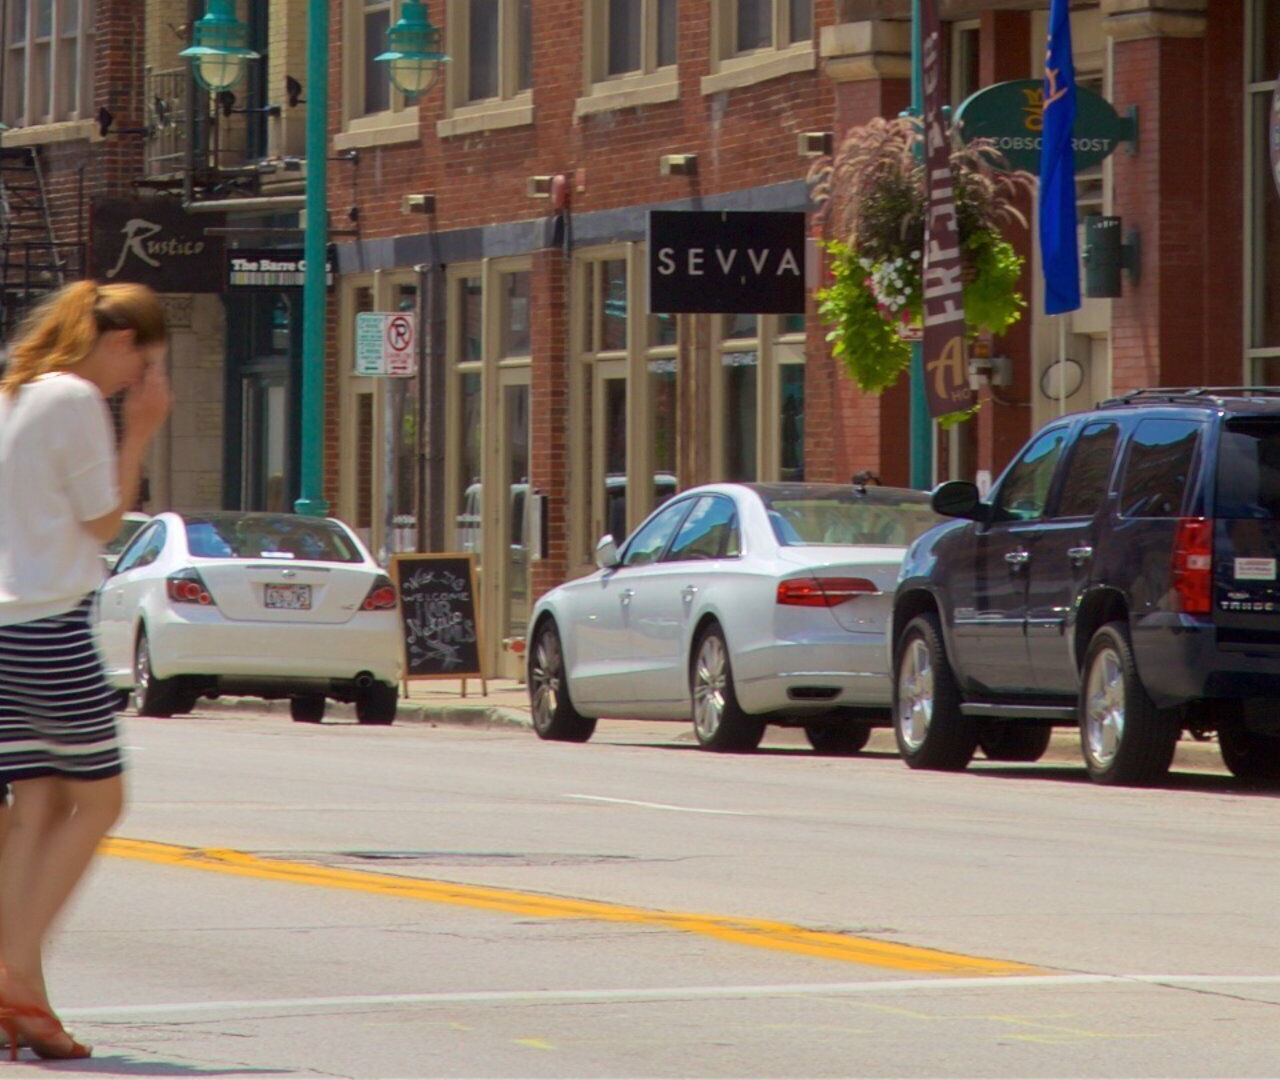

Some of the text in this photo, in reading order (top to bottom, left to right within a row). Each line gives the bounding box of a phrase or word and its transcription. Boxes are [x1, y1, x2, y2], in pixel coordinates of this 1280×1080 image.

[105, 218, 206, 279] Rustico
[657, 247, 802, 276] SEVVA
[231, 258, 258, 272] The
[260, 258, 296, 272] Barre
